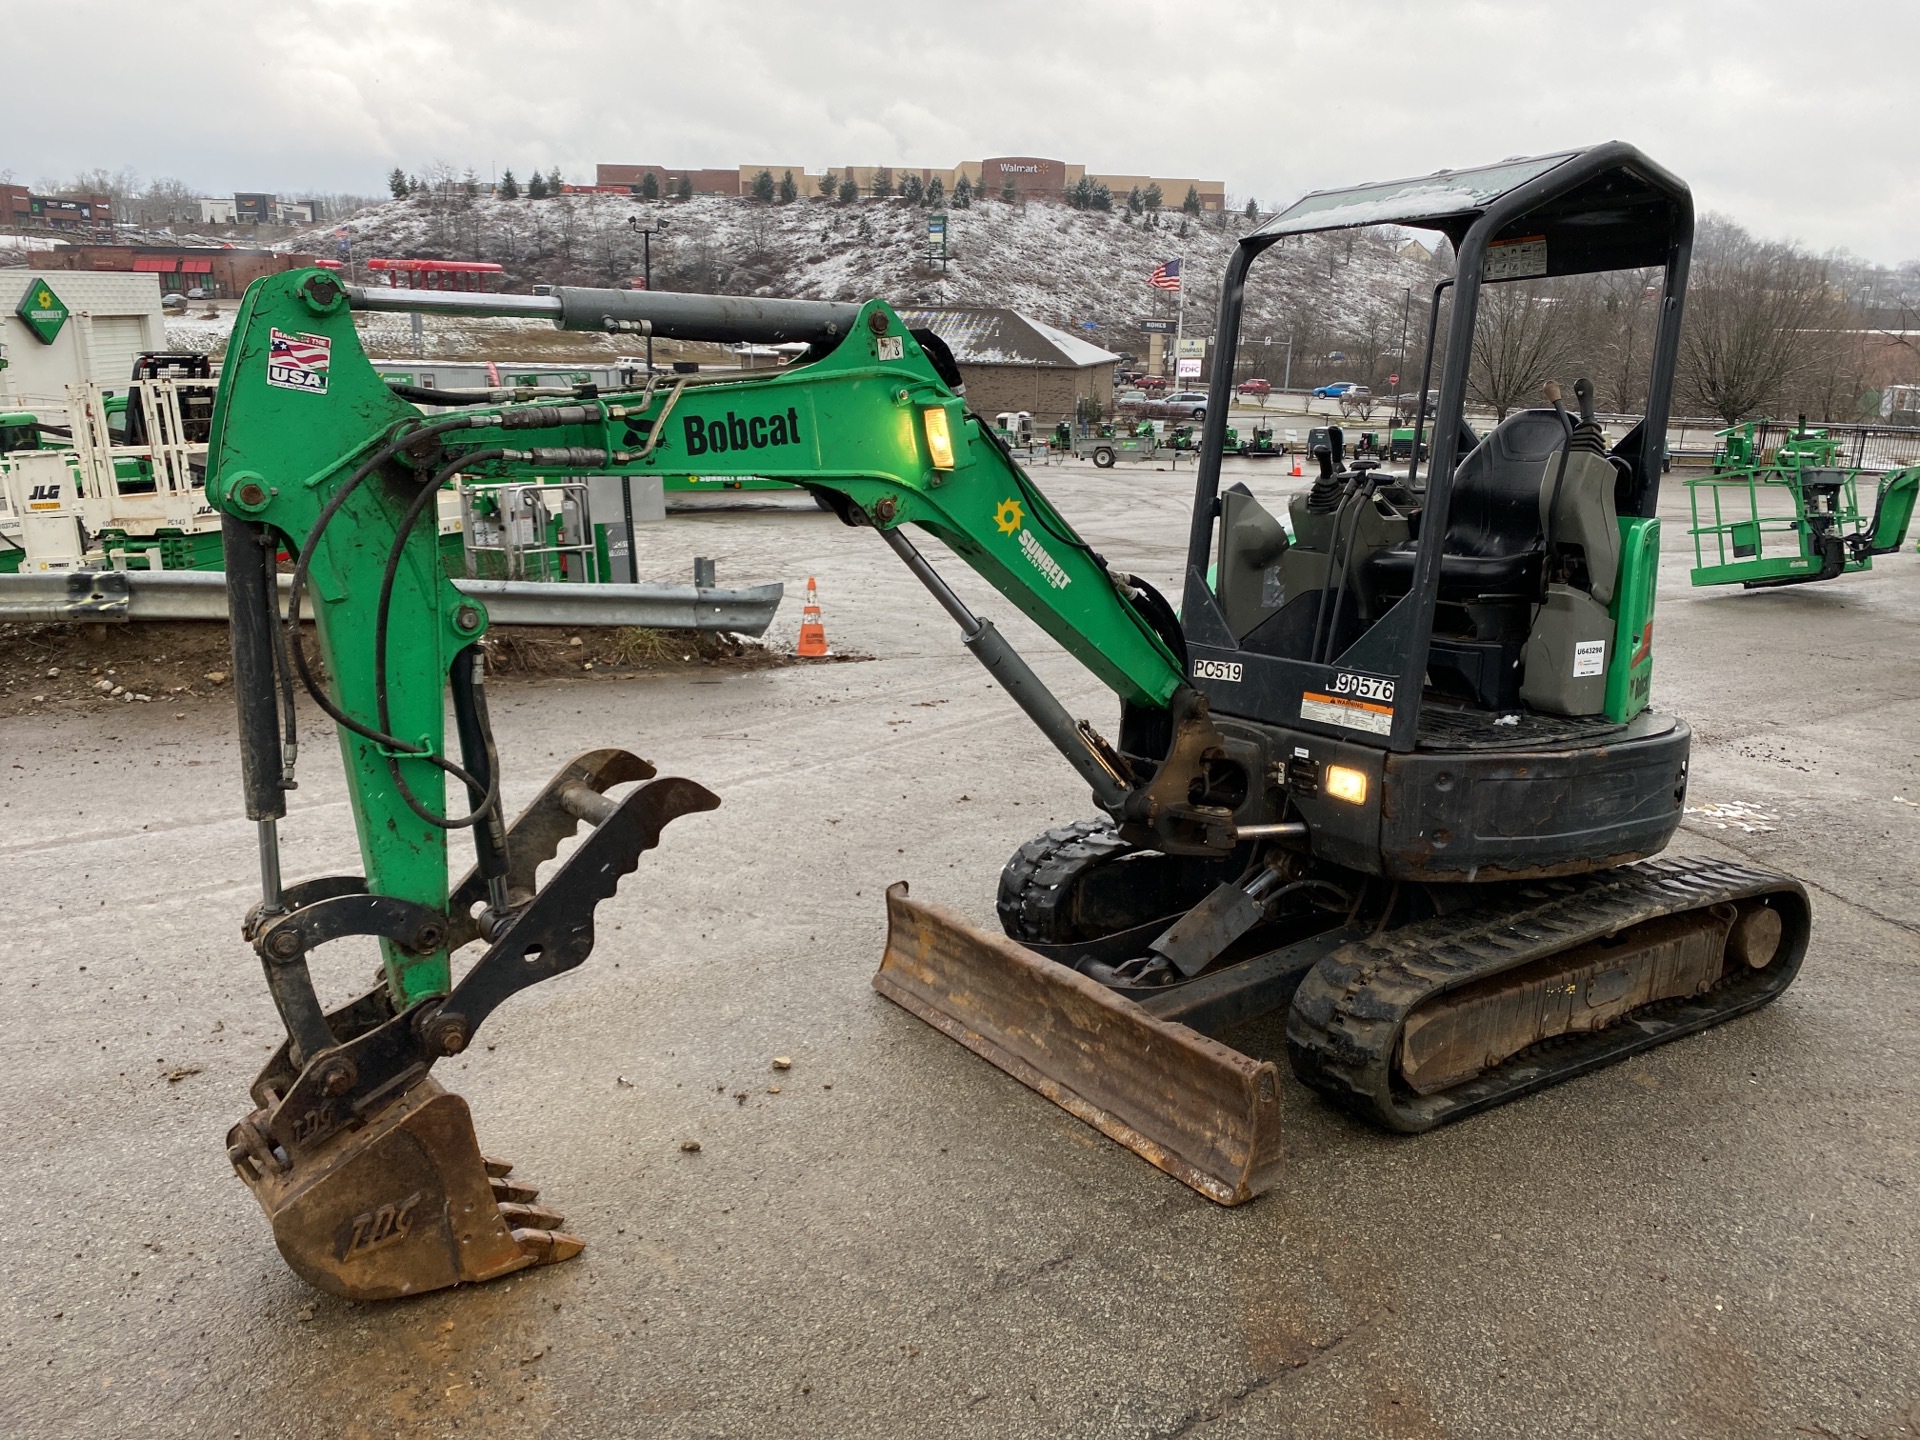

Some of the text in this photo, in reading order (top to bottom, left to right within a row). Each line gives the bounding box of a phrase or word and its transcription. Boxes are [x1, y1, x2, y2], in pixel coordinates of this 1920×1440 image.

[1000, 163, 1038, 173] Walmart
[271, 367, 321, 388] USA
[683, 407, 801, 456] Bobcat
[28, 485, 60, 500] JLG
[1018, 529, 1072, 590] SUNBELT
[1021, 547, 1058, 589] RENTALS
[1194, 660, 1242, 680] PC519
[1337, 699, 1364, 709] WARNING
